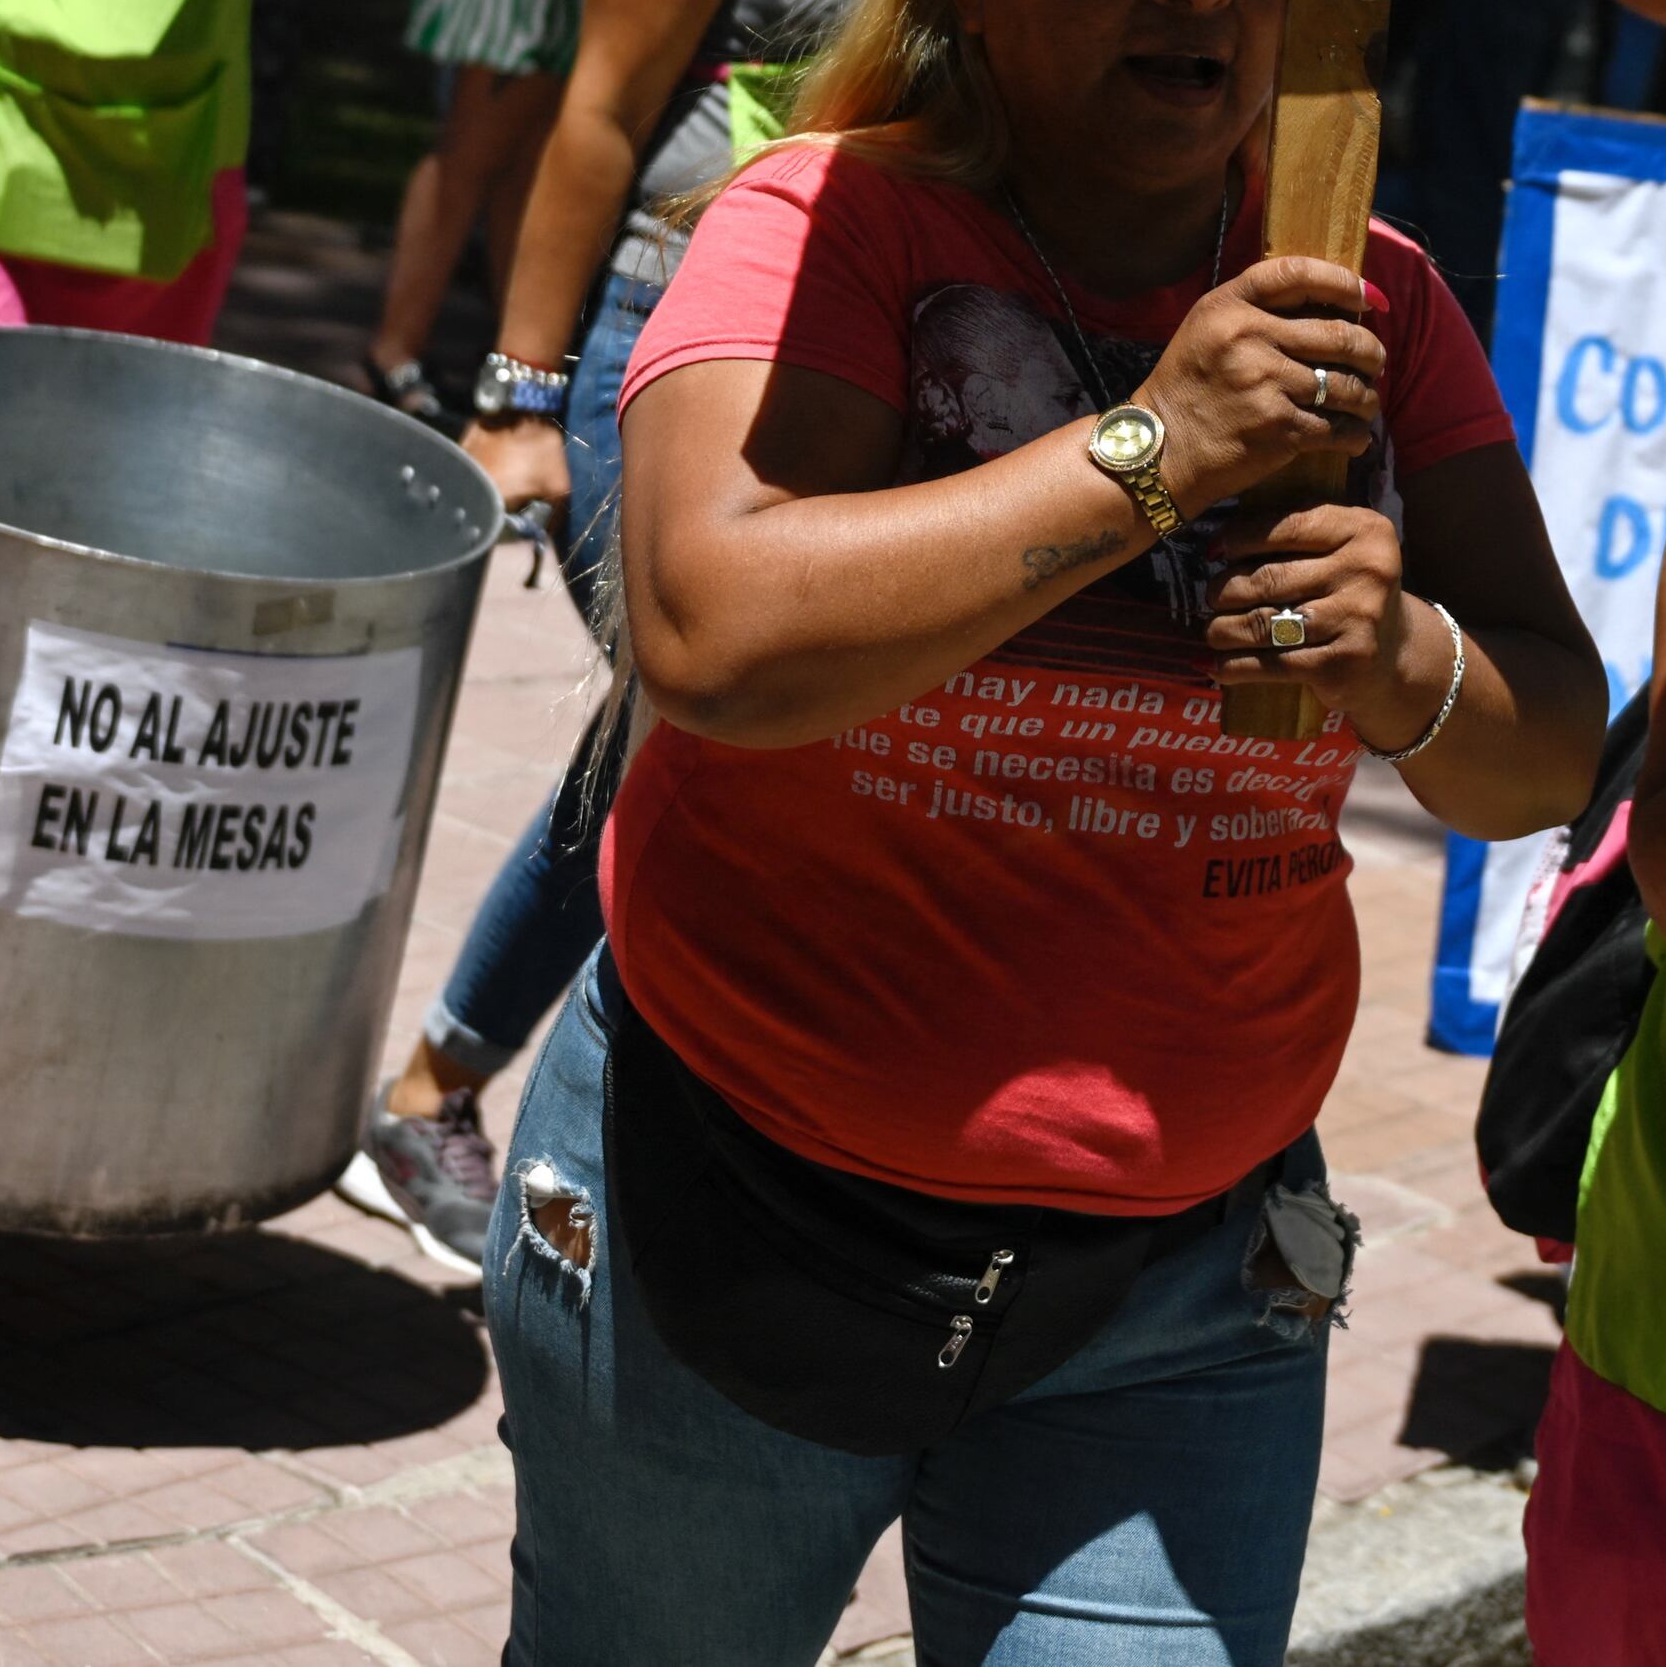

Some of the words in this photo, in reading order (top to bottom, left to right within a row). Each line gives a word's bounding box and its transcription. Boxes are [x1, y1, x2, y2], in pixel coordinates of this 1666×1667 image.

[52, 674, 123, 754] NO
[129, 690, 187, 765] AL
[197, 697, 362, 769] AJUSTE
[1050, 682, 1165, 716] nada
[959, 712, 1045, 739] que
[1059, 719, 1117, 741] un
[1127, 726, 1281, 760] pueblo.
[906, 740, 957, 771] se
[972, 748, 1157, 792] necesita
[1170, 765, 1216, 795] es
[30, 783, 100, 856] EN
[104, 794, 164, 868] LA
[172, 801, 317, 872] MESAS
[850, 769, 919, 806] ser
[925, 779, 1054, 834] justo,
[1068, 794, 1161, 839] libre
[1173, 813, 1197, 849] y
[1201, 854, 1282, 900] EVITA
